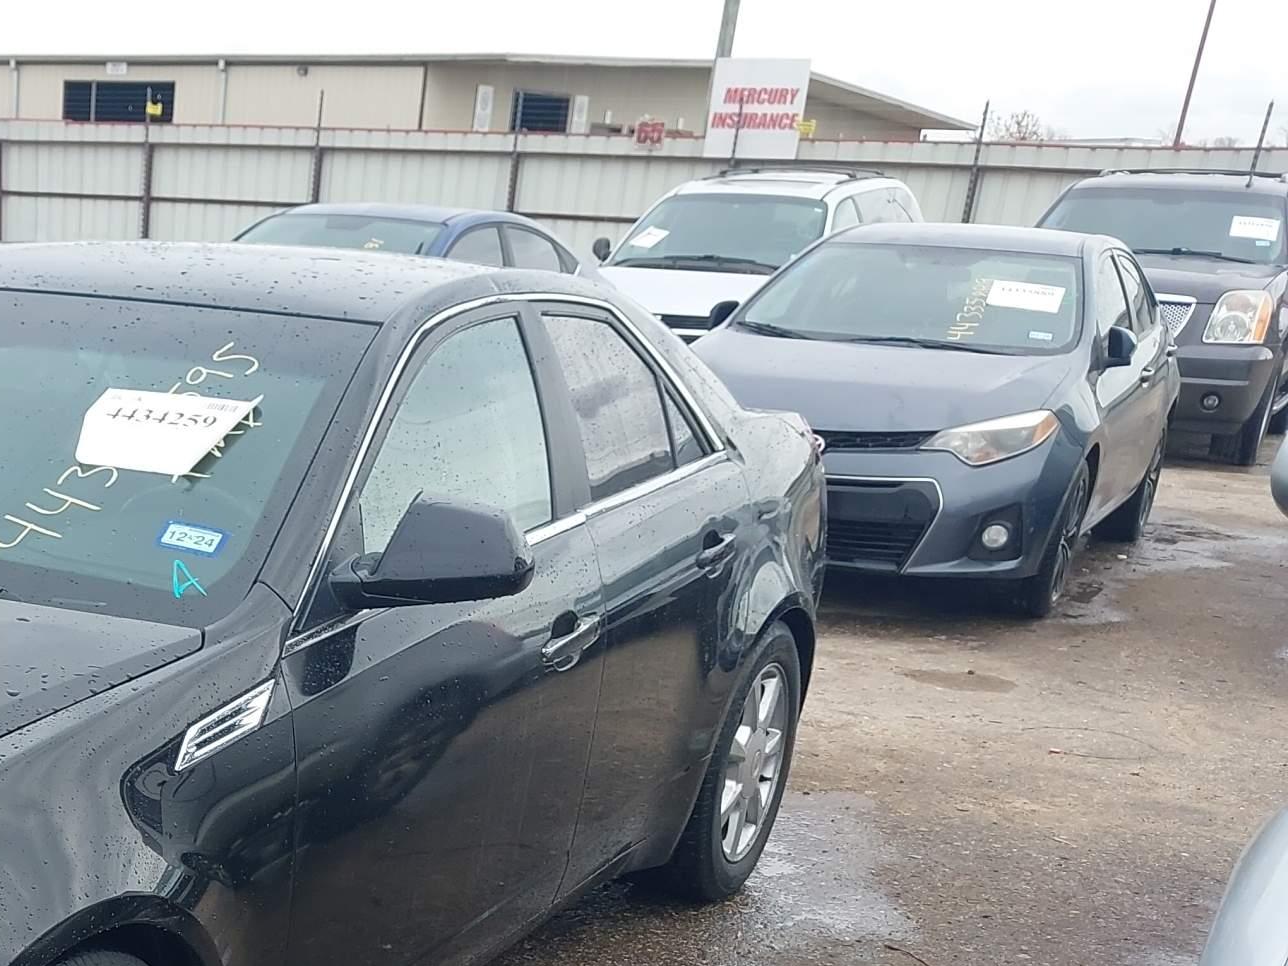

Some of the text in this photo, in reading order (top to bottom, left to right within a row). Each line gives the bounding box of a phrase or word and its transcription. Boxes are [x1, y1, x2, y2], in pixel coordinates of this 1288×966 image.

[723, 87, 799, 105] MERCURY
[712, 112, 798, 130] INSURANCE
[173, 559, 208, 598] A
